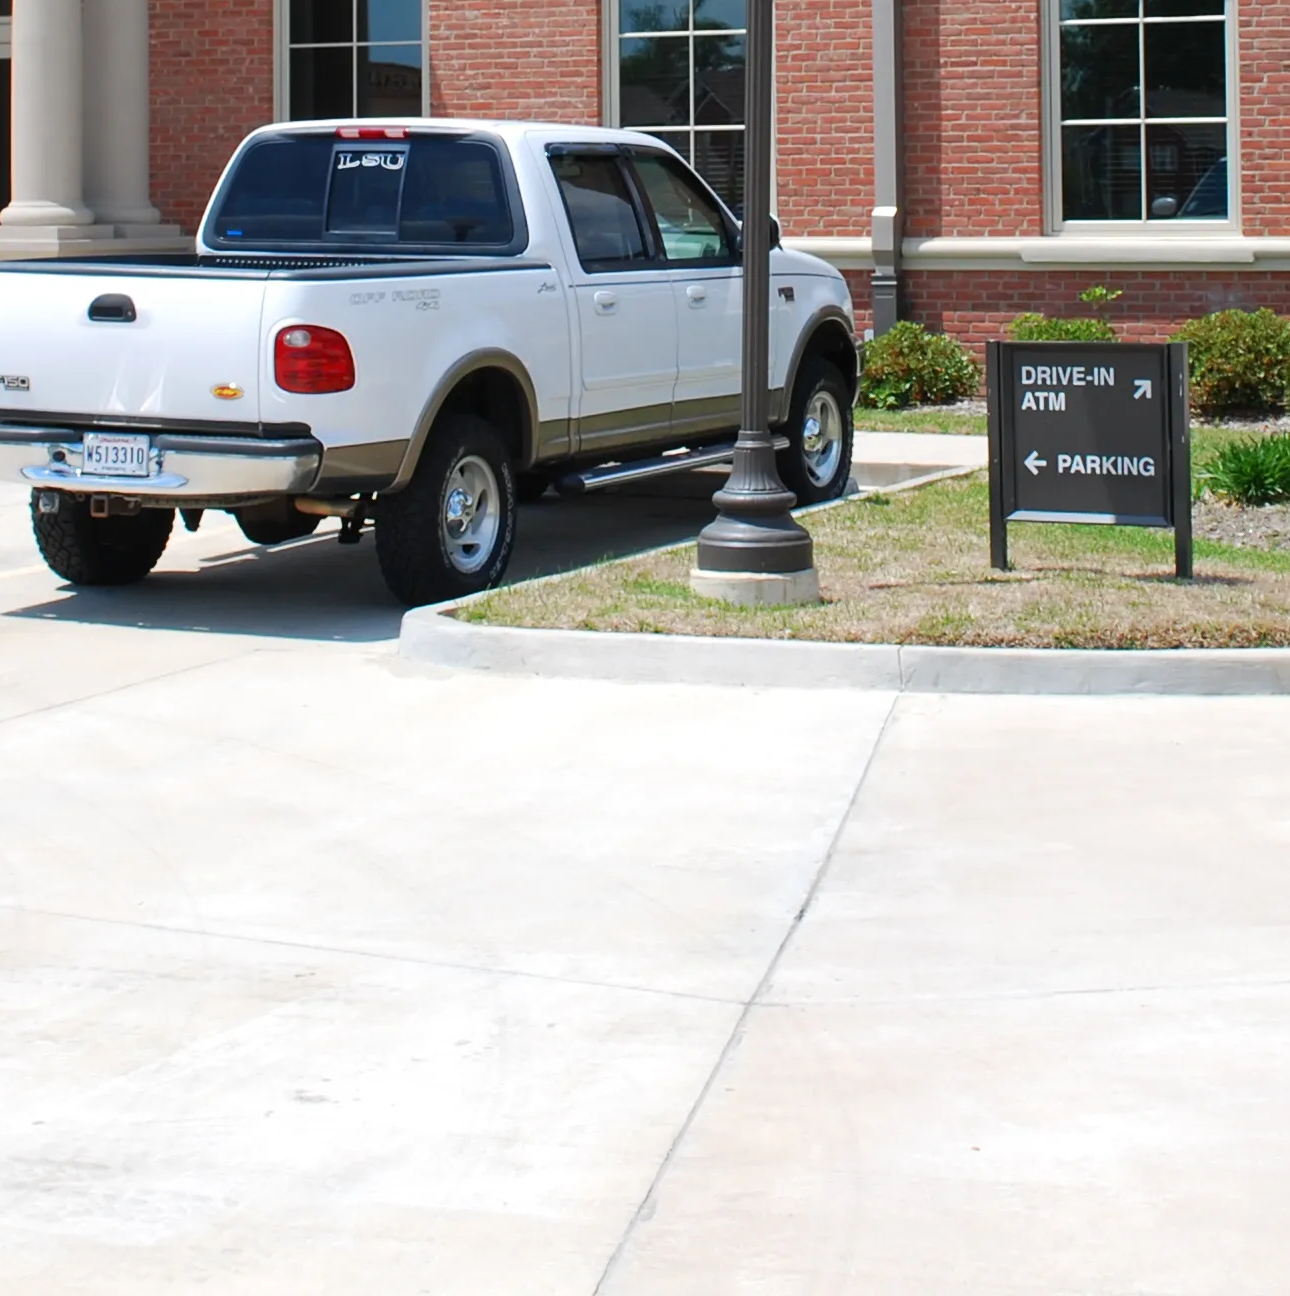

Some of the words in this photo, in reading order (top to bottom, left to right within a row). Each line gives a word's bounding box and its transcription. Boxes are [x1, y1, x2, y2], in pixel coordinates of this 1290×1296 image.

[337, 153, 405, 170] LSU
[350, 292, 387, 305] OFF
[391, 288, 441, 302] ROAD
[1021, 366, 1115, 387] DRIVE-IN
[1021, 391, 1066, 412] ATM
[1057, 454, 1156, 477] PARKING
